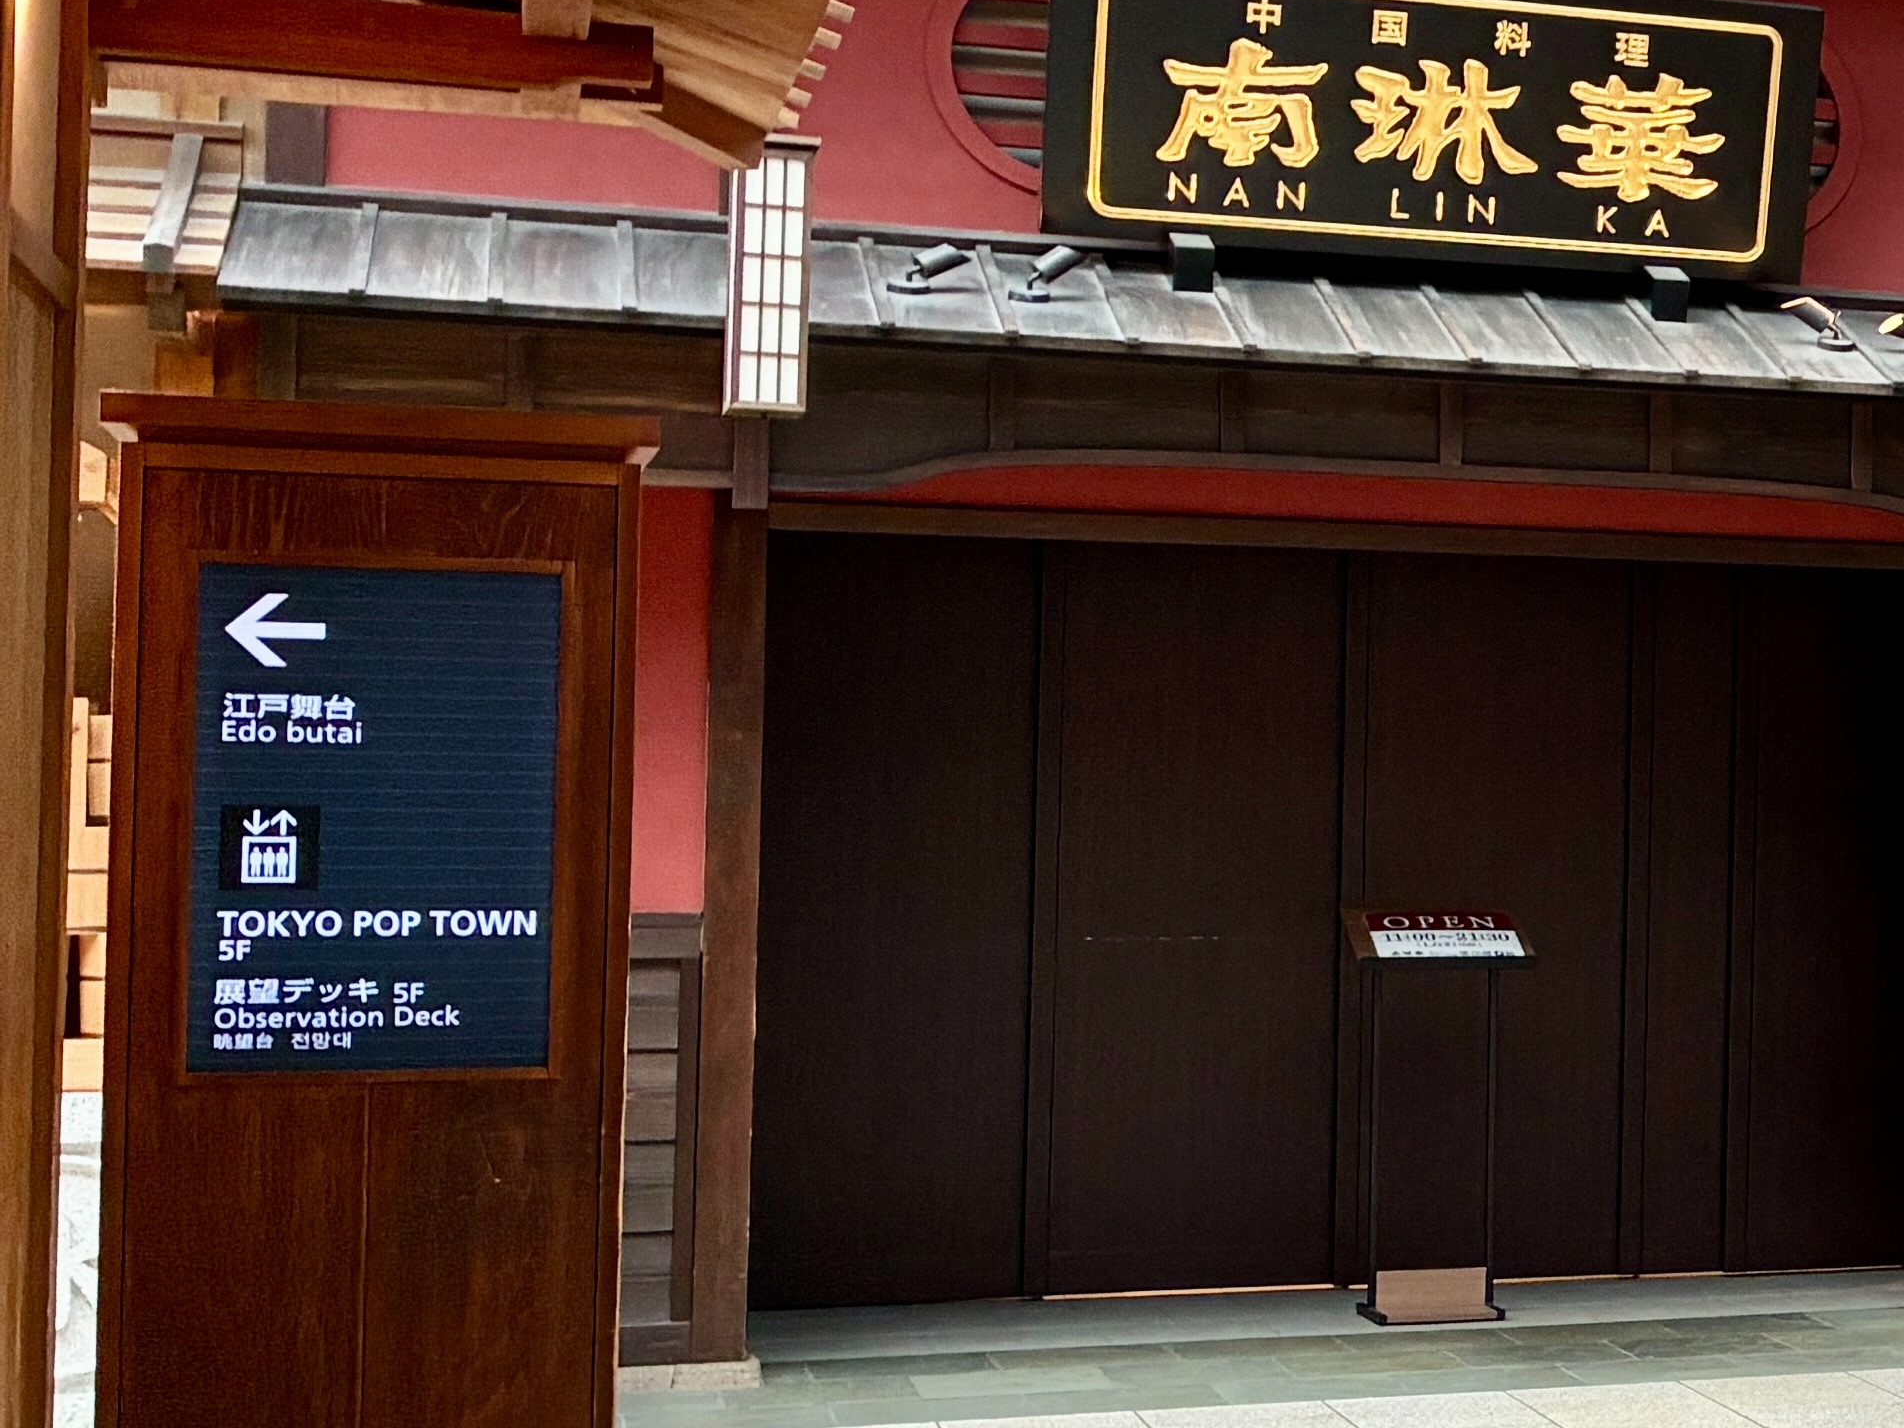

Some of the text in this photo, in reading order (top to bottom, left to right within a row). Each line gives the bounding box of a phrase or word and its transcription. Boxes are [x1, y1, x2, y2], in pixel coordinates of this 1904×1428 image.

[1156, 36, 1725, 204] 南琳華
[1167, 173, 1671, 239] NAN LIN KA
[222, 693, 356, 720] 江戸舞台
[221, 721, 362, 744] Edo butai
[217, 910, 537, 938] TOKYO POP TOWN
[1383, 916, 1494, 928] OPEN
[218, 940, 251, 961] 5F
[214, 978, 424, 1004] 展望デッキ 5F
[214, 1006, 459, 1029] Observation Deck
[291, 1031, 352, 1050] 전망대
